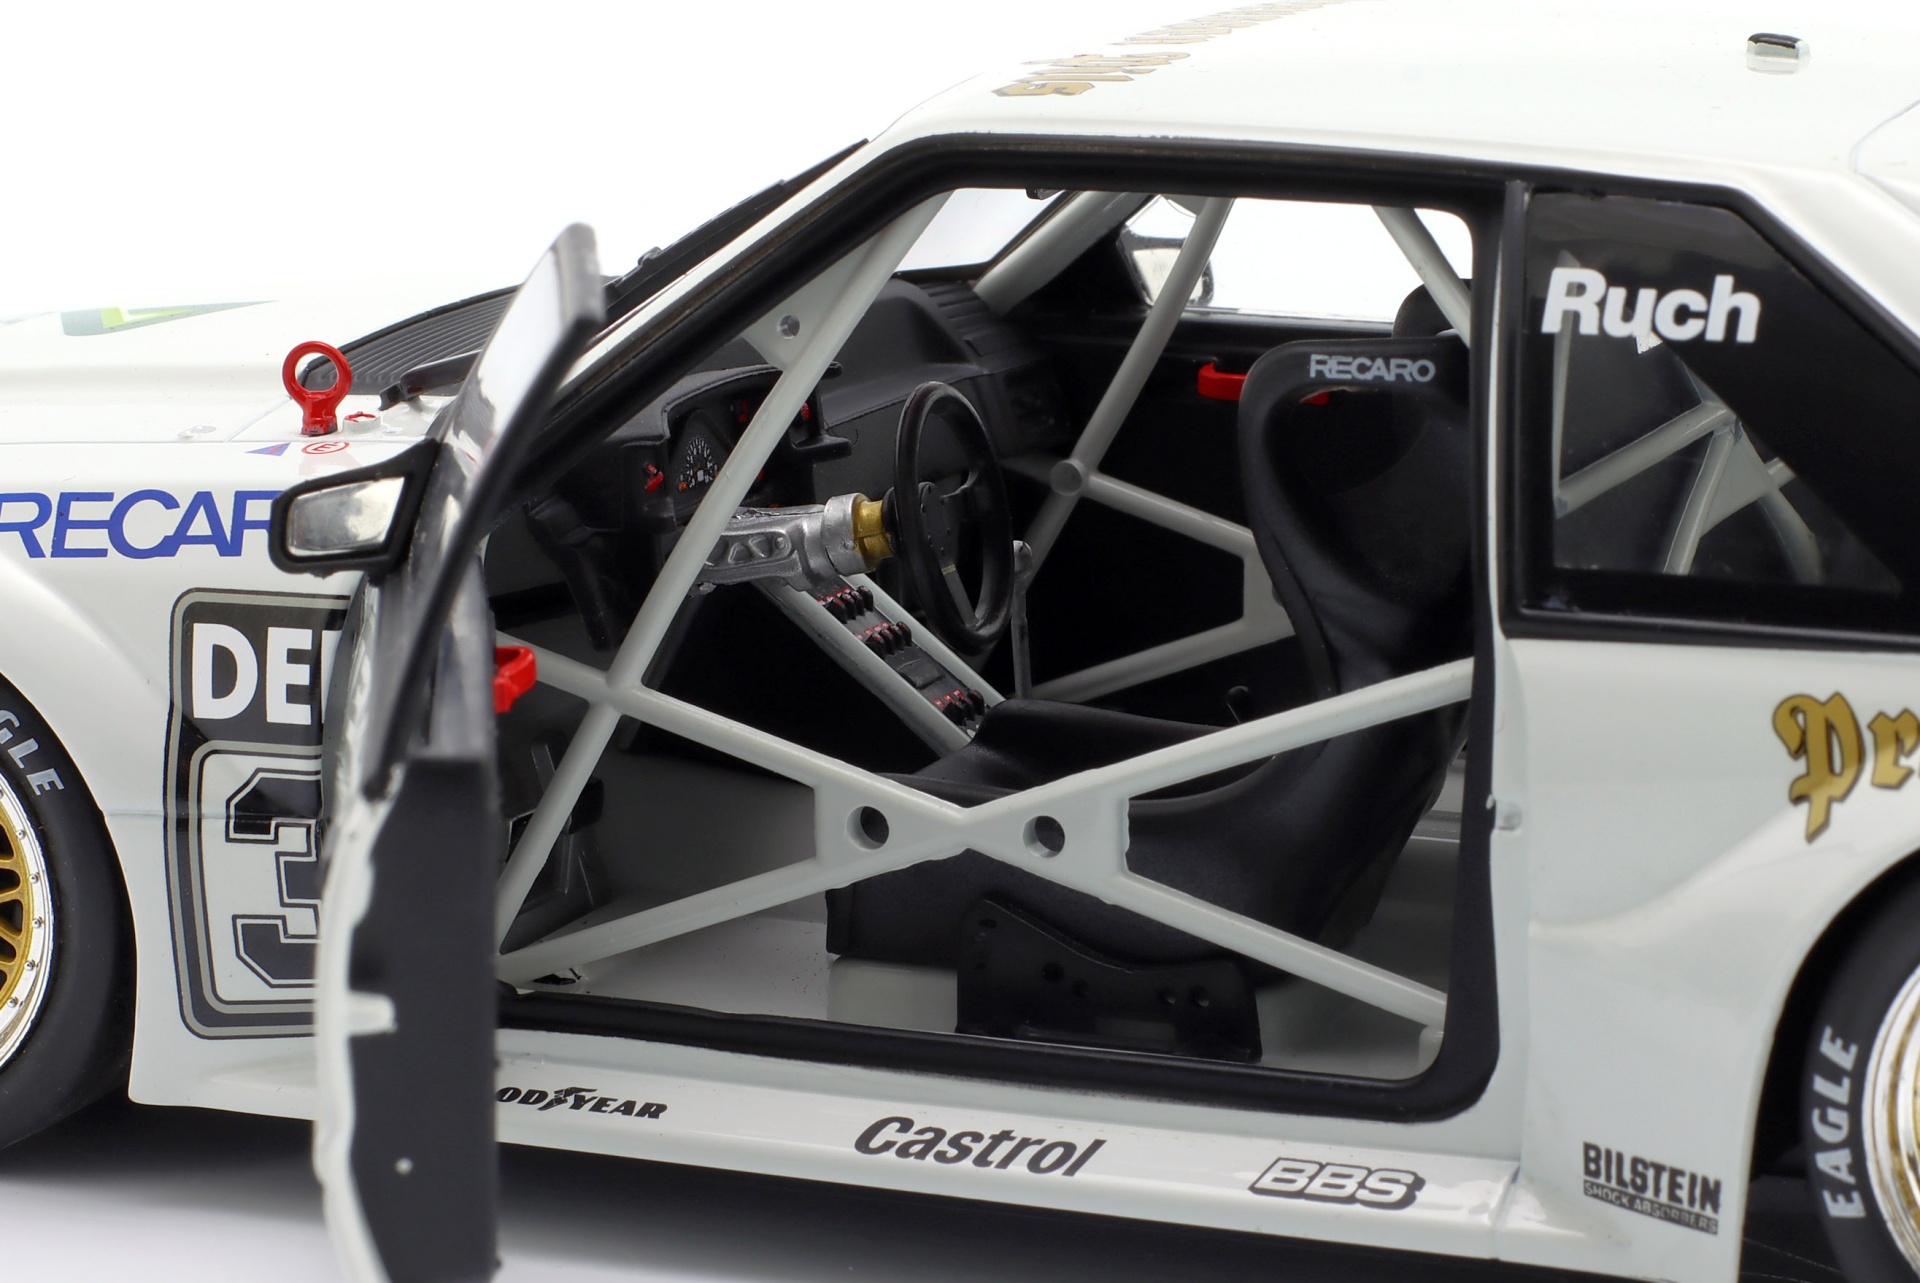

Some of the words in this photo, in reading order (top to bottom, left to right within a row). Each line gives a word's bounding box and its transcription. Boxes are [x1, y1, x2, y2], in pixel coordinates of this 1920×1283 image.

[1541, 267, 1762, 343] Ruch
[1309, 353, 1437, 383] RECARO
[854, 1116, 1107, 1177] Castrol
[1811, 1025, 1867, 1219] EAGLE
[1248, 1157, 1426, 1211] BBS
[1583, 1141, 1721, 1215] BILSTEIN
[1584, 1181, 1630, 1207] SHOCK
